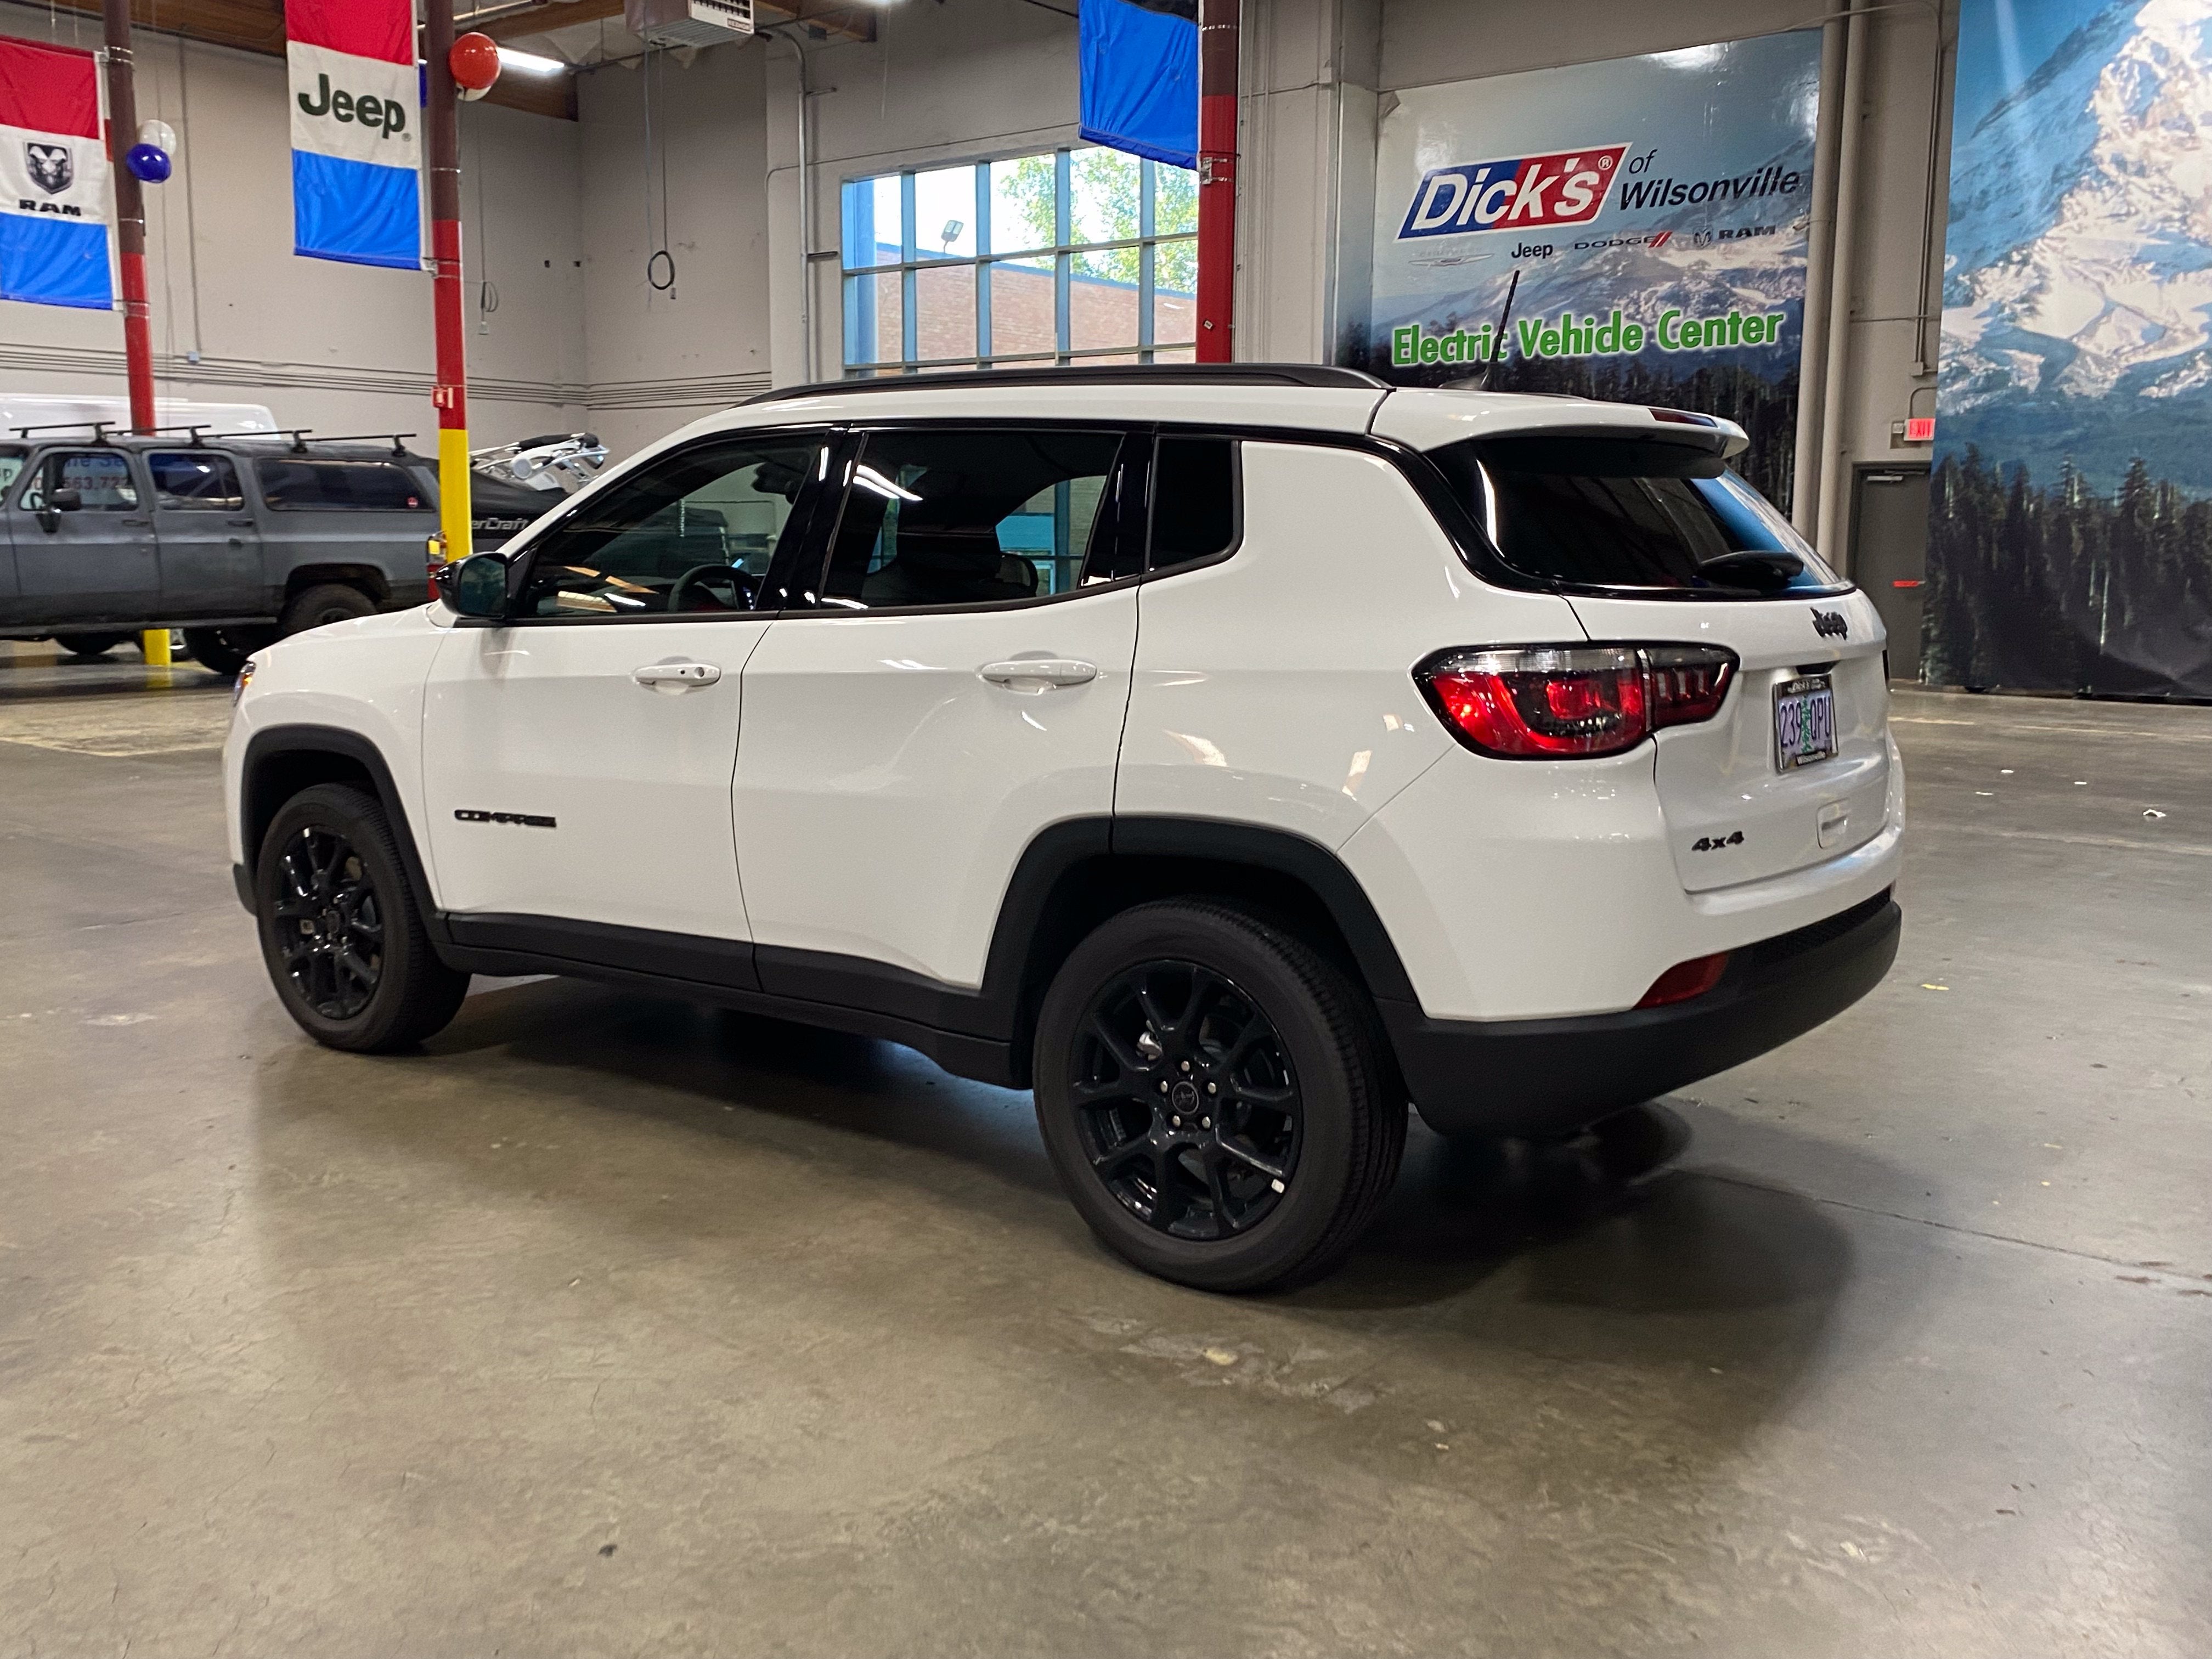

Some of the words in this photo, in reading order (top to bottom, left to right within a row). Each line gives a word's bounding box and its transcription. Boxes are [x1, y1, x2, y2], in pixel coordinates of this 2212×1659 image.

[298, 73, 406, 139] Jeep
[19, 199, 81, 216] RAM
[1411, 157, 1600, 230] Dick's
[1628, 149, 1658, 174] of
[1620, 166, 1800, 211] Wilsonville
[1511, 242, 1554, 259] Jeep
[1575, 236, 1656, 250] DODGE
[1718, 225, 1776, 239] RAM
[1519, 311, 1643, 357] Vehicle
[1658, 310, 1784, 349] Center
[1910, 421, 1931, 437] EXIT
[1810, 607, 1848, 640] Jeep
[1780, 702, 1802, 748] 239
[1811, 696, 1831, 740] QPU
[1691, 831, 1745, 851] 4x4
